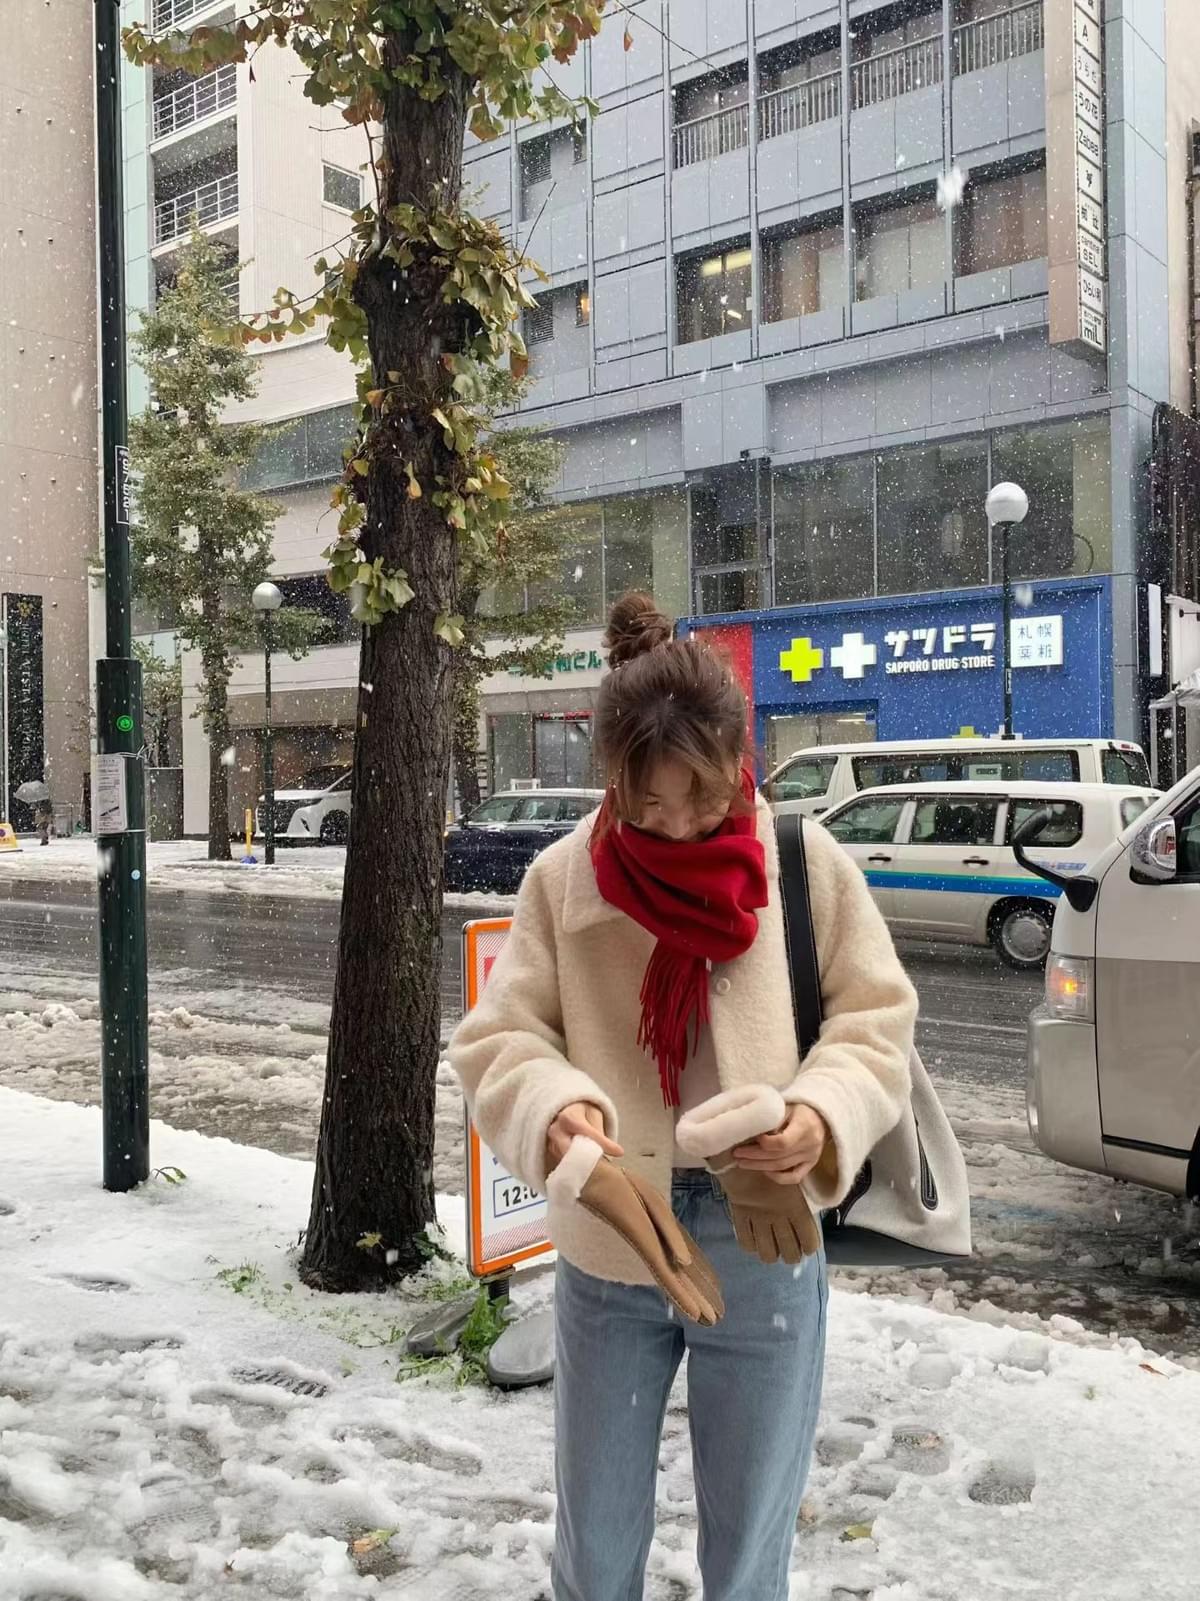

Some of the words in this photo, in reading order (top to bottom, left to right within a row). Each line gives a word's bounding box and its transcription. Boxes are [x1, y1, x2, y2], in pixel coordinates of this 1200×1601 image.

[885, 660, 930, 674] SAPPORO
[932, 657, 960, 671] DRUG
[961, 654, 996, 669] STORE
